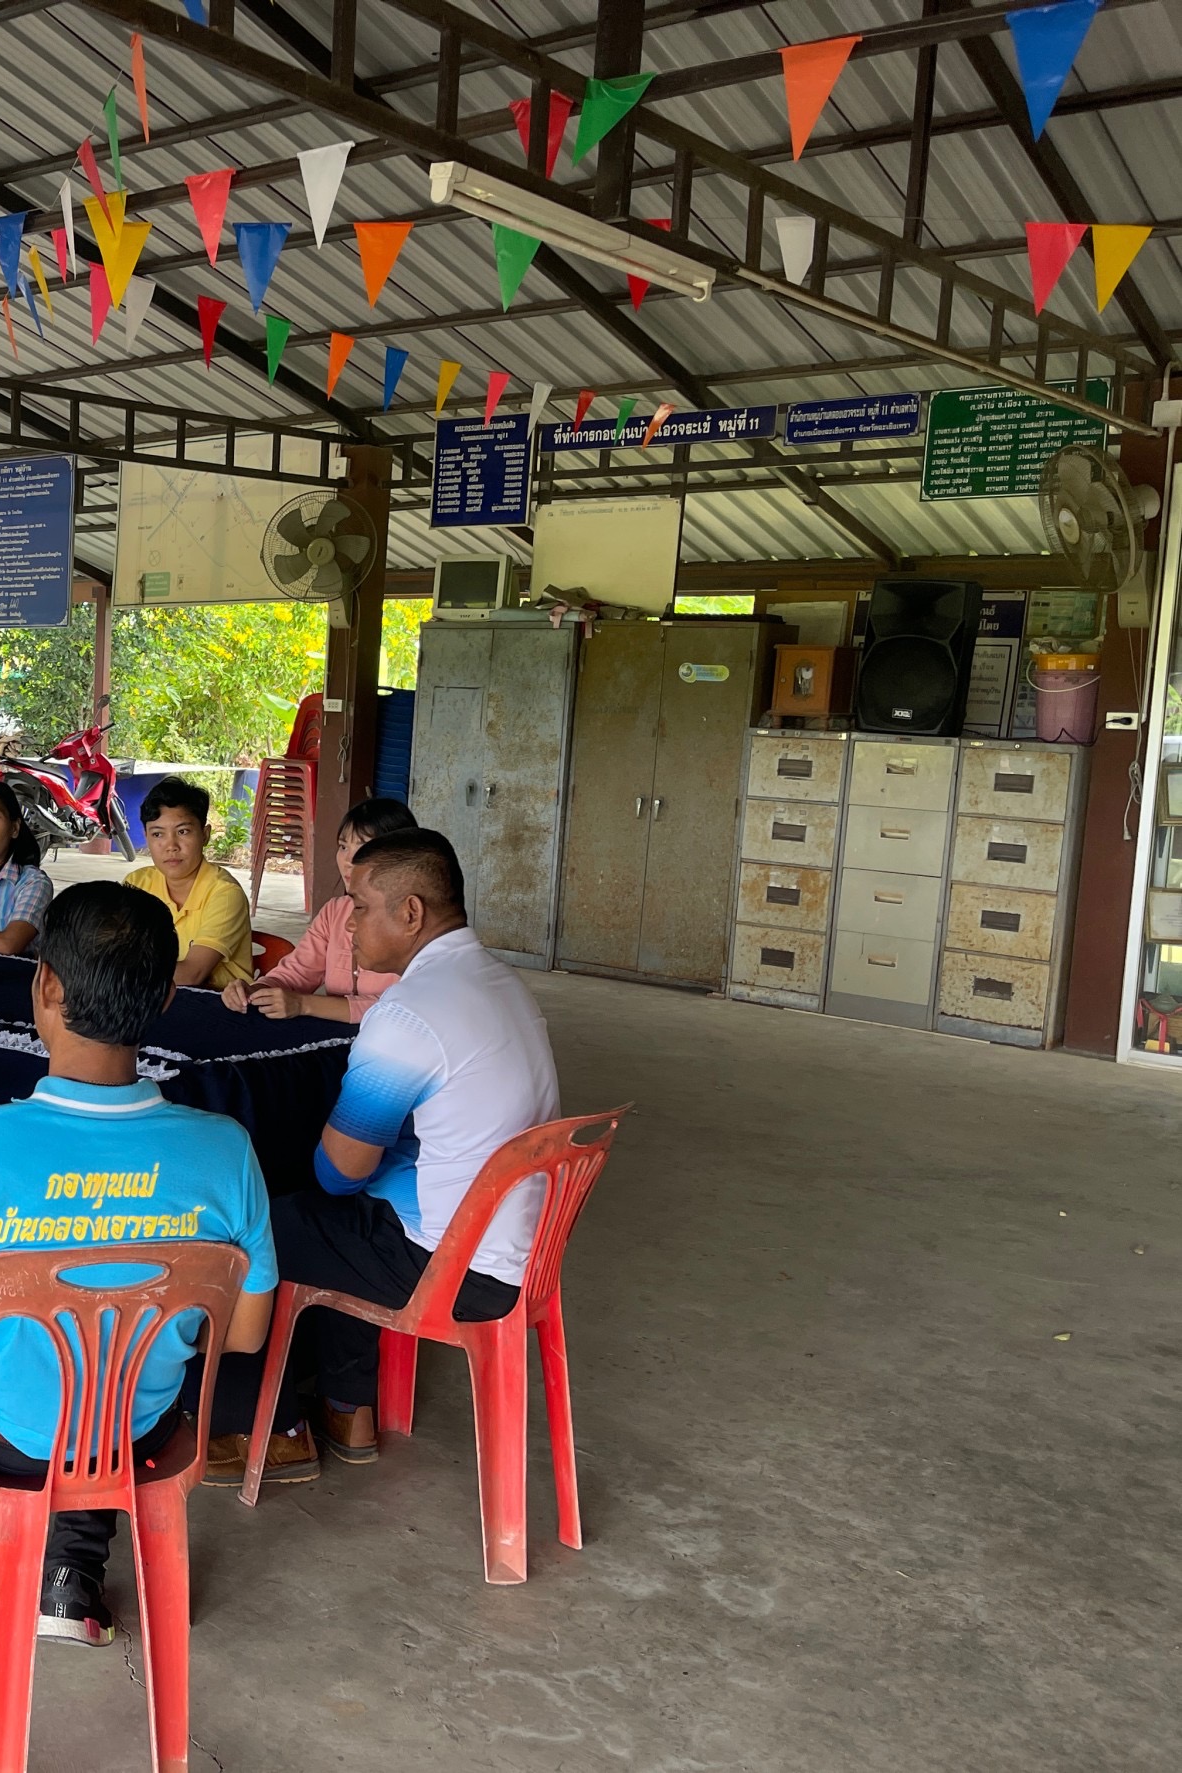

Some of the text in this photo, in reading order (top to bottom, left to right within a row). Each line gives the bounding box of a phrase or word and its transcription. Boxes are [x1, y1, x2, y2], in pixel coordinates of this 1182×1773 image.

[717, 408, 748, 439] หมู่ที่
[748, 421, 760, 436] 11
[44, 1161, 160, 1209] กองทุนแม่
